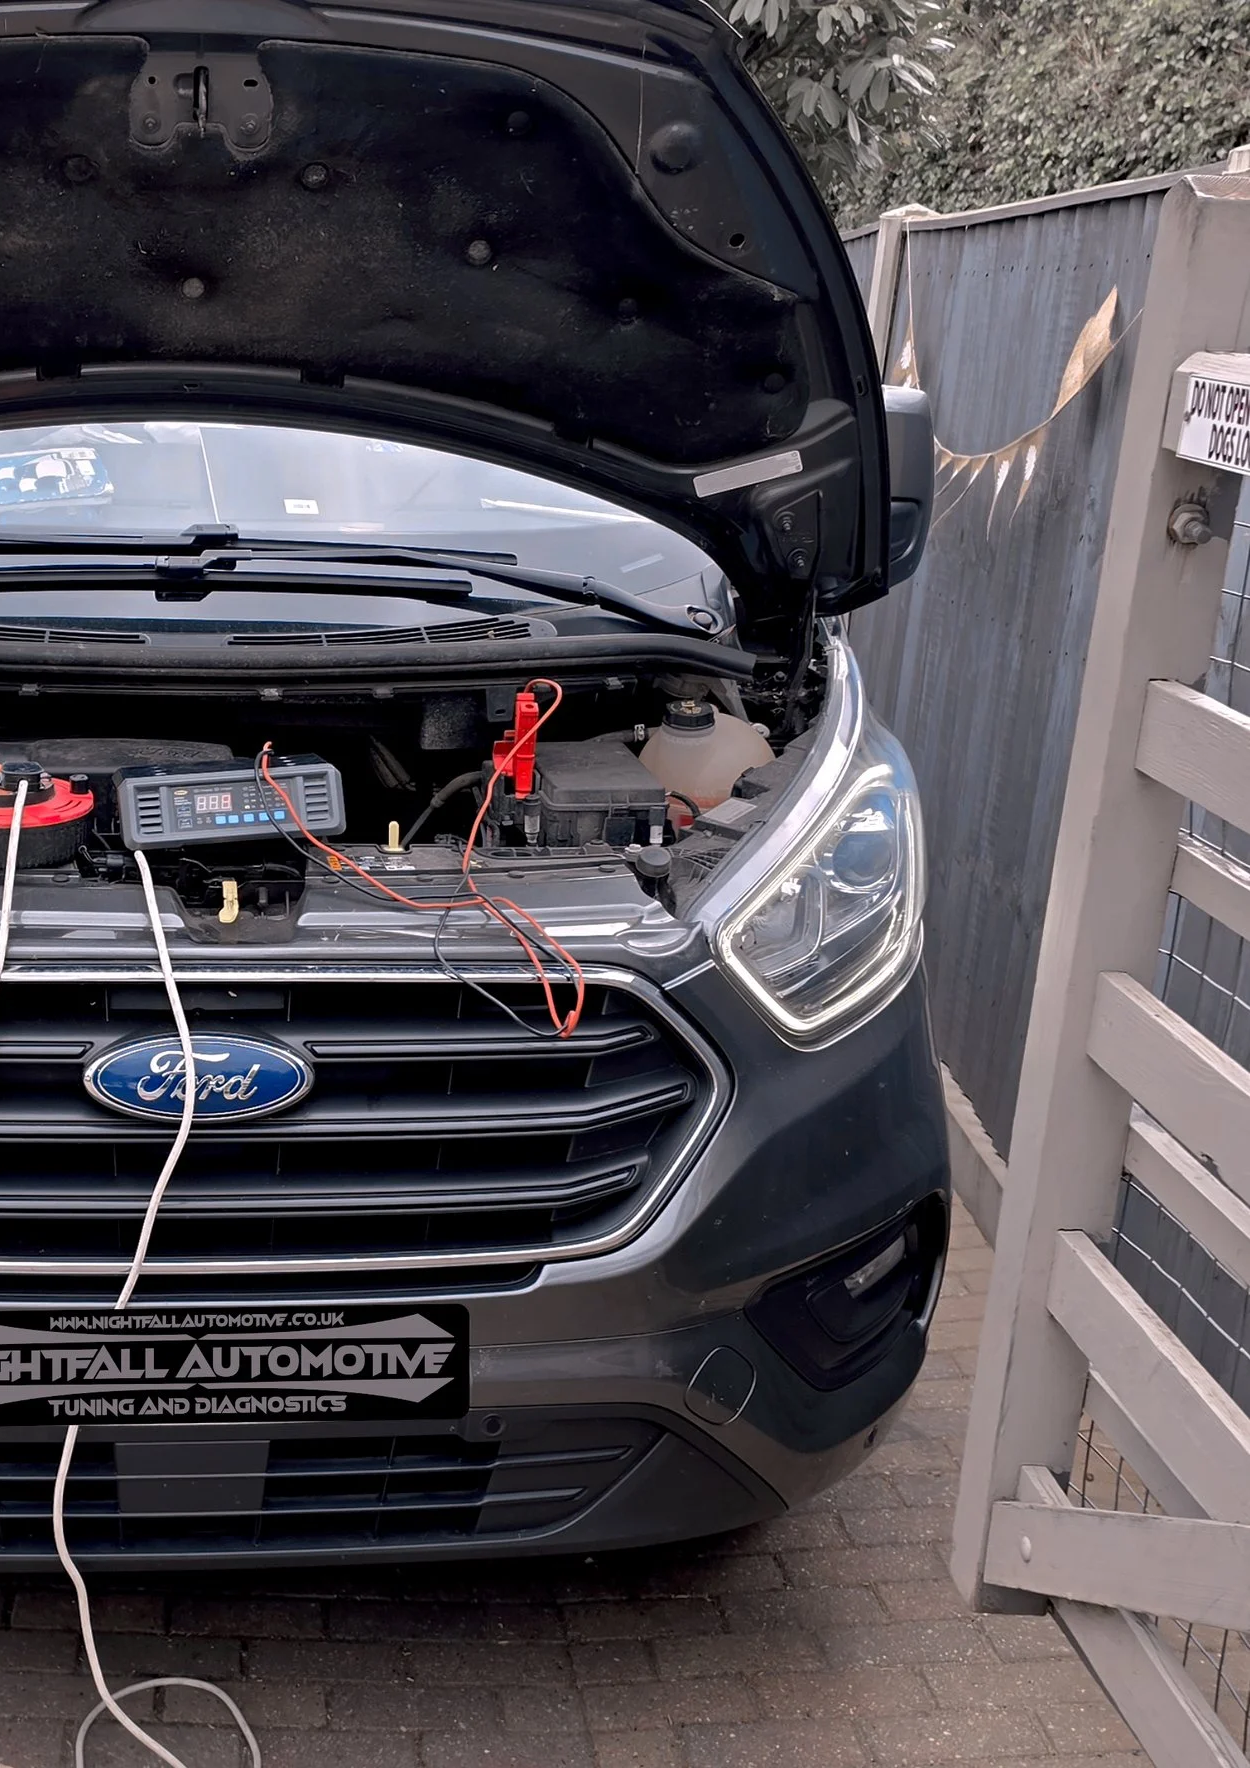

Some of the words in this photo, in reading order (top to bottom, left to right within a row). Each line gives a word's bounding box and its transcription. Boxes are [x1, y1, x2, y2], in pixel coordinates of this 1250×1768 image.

[1190, 380, 1206, 417] DO
[1204, 383, 1227, 421] NOT
[1208, 423, 1237, 464] DOGS
[1234, 429, 1250, 469] LO
[137, 1050, 261, 1101] Ford
[49, 1311, 345, 1331] WWW.NIGHTFALLAUTOMOTIVE.CO.UK
[175, 1343, 456, 1380] AUTOMOTIVE
[48, 1397, 135, 1417] TUNING
[138, 1396, 190, 1416] AND
[194, 1394, 348, 1415] DIAGNOSTICS
